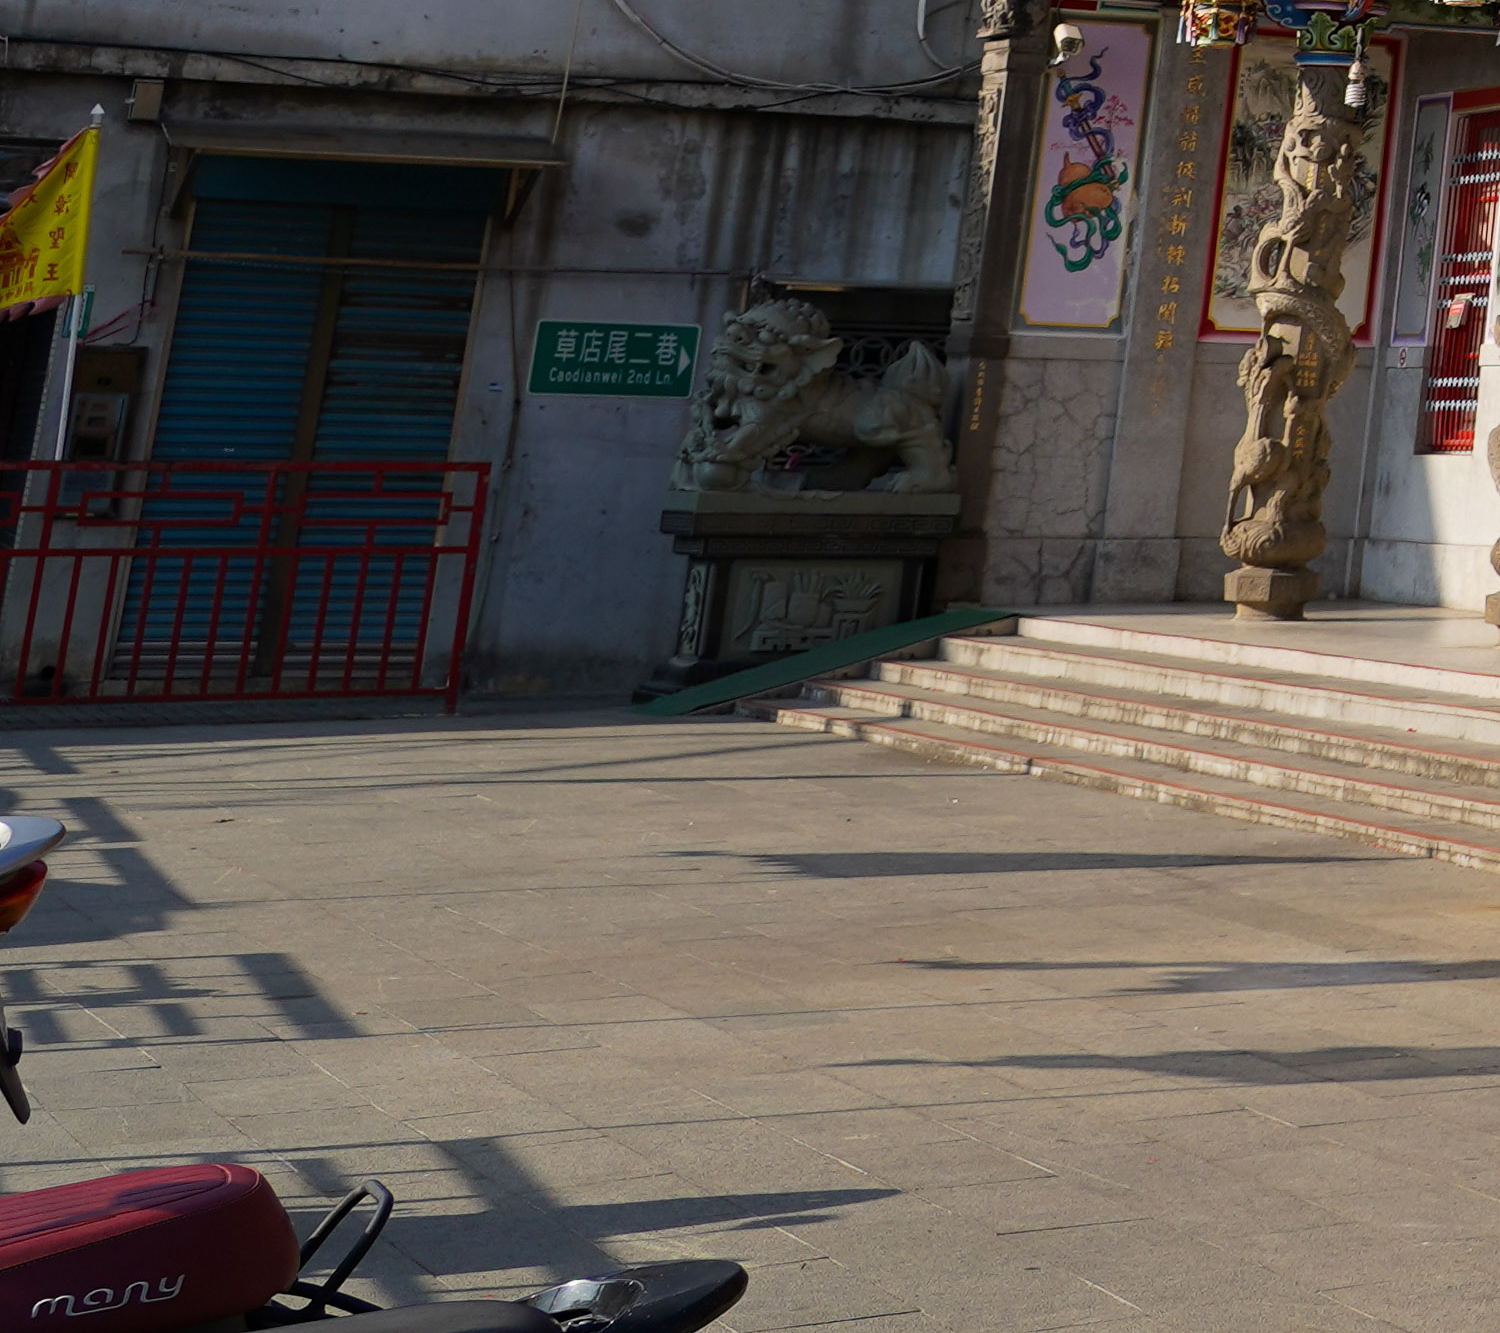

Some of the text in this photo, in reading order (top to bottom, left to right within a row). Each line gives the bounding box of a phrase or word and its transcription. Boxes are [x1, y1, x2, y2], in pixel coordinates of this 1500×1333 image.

[554, 329, 678, 366] 草店尾二巷
[549, 367, 623, 384] Caodianwei
[627, 369, 652, 384] 2nd
[31, 1274, 185, 1318] many
